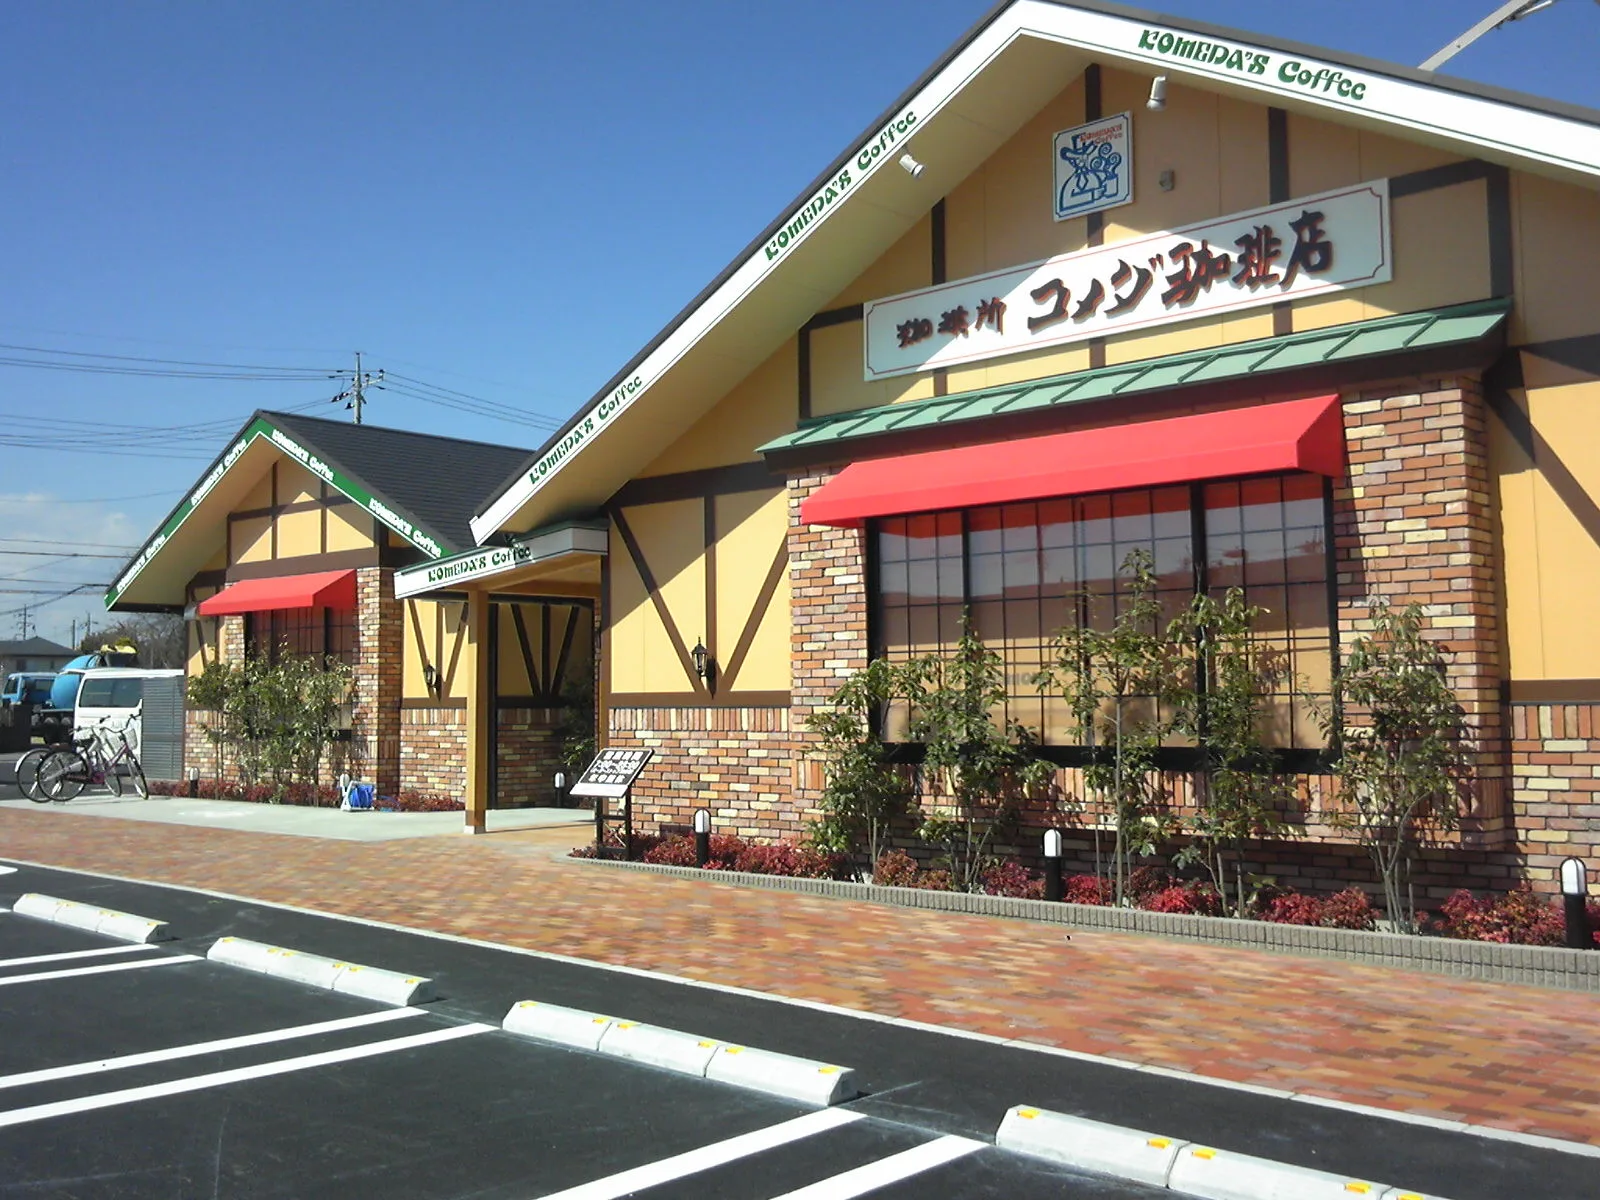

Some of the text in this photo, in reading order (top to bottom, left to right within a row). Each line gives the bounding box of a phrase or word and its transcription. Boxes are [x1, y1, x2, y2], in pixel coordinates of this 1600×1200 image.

[1138, 29, 1367, 101] KOMEDA'S Coffee
[764, 111, 917, 261] KOMEDA'S Coffee
[598, 376, 643, 420] Coffee
